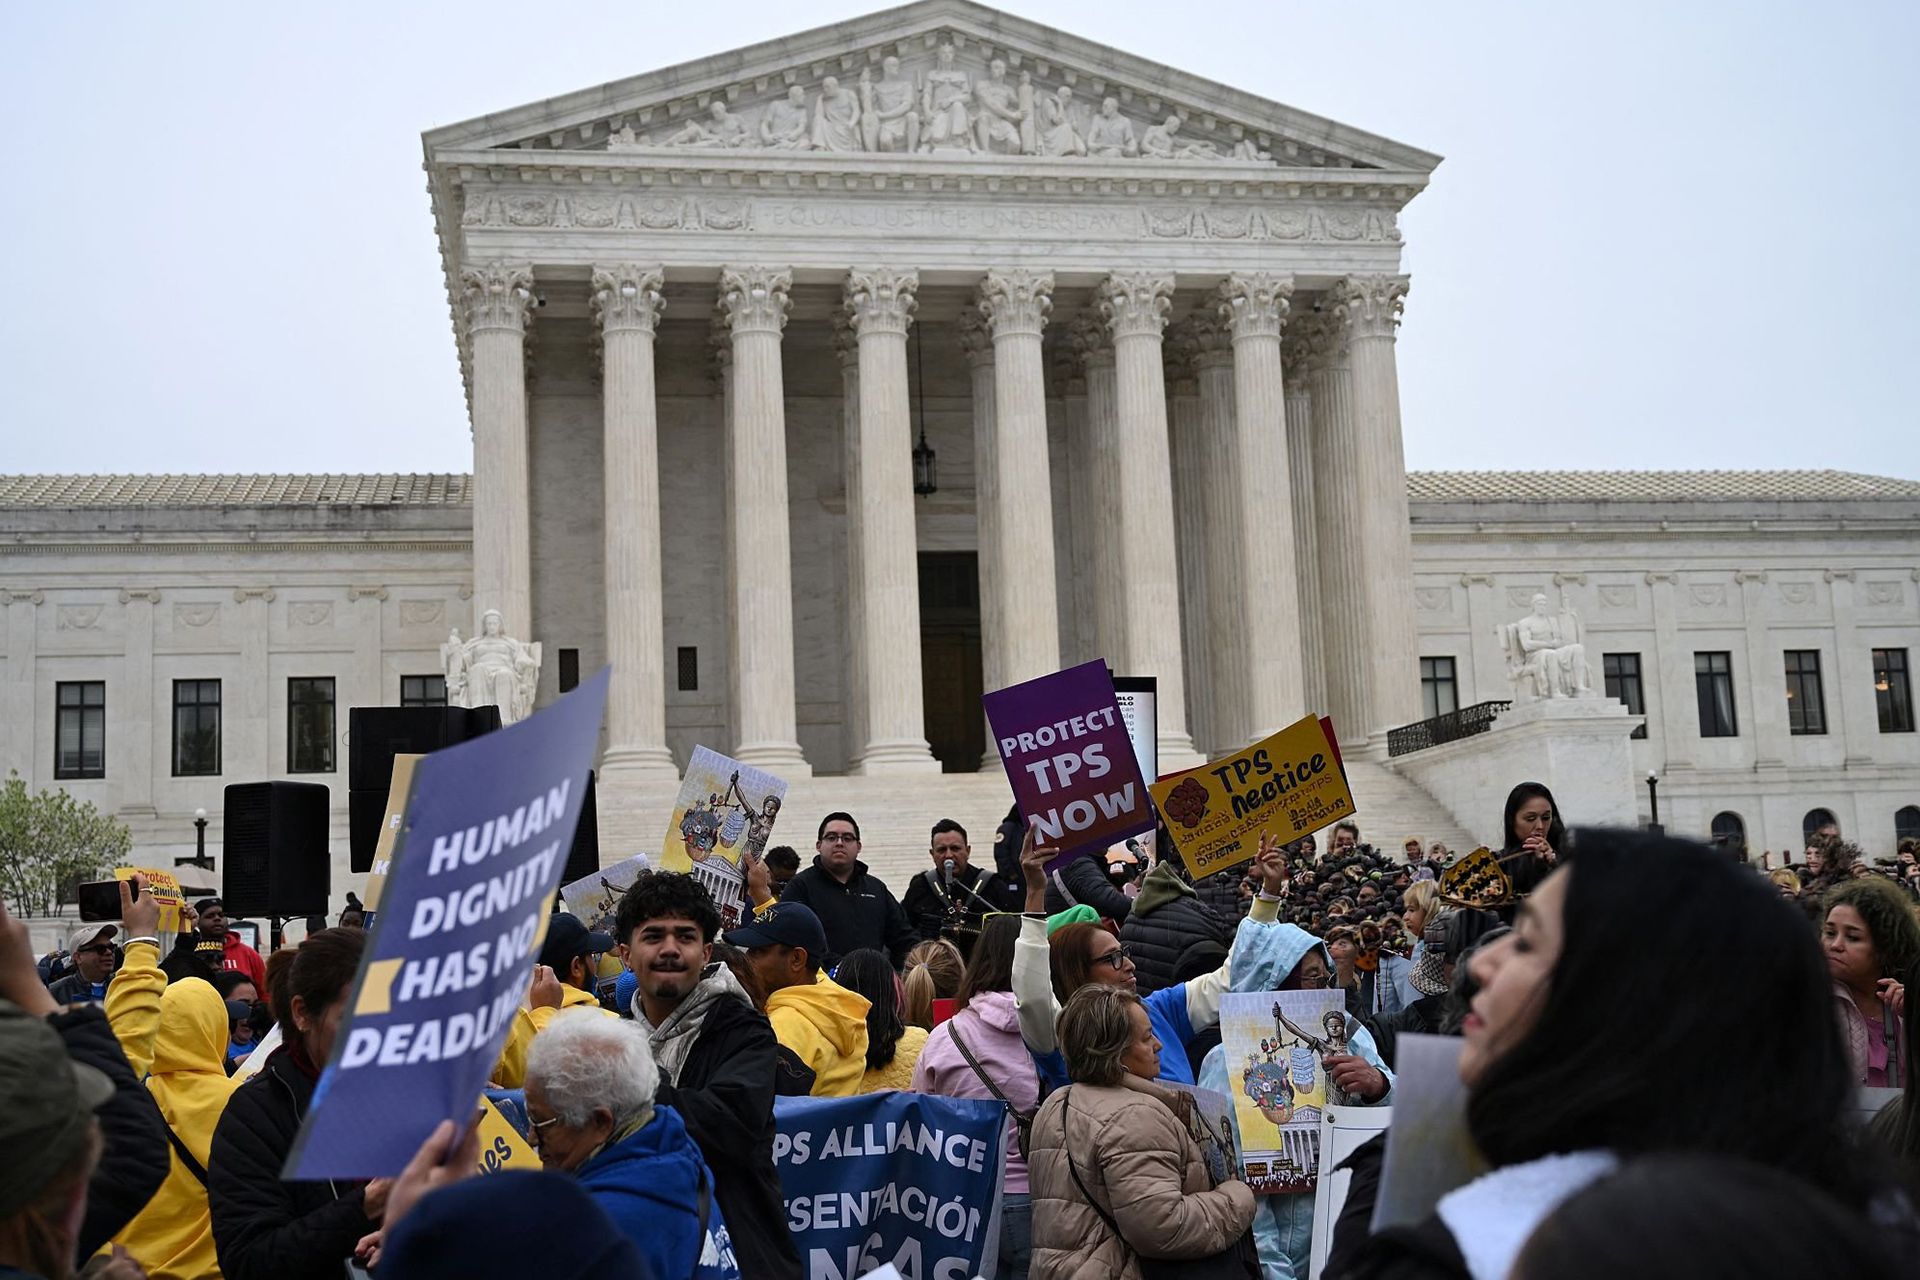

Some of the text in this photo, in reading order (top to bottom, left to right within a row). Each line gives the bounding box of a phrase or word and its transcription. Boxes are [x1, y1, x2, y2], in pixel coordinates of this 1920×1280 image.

[772, 206, 1121, 231] EQUAL JUSTICE UNDER LAW
[1000, 706, 1115, 758] PROTECT
[1025, 743, 1111, 795] TPS
[1211, 749, 1273, 793] TPS
[427, 778, 571, 876] HUMAN
[1028, 781, 1136, 846] NOW
[408, 839, 561, 939] DIGNITY
[398, 913, 539, 1001] HAS NO
[818, 1120, 987, 1173] ALLIANCE
